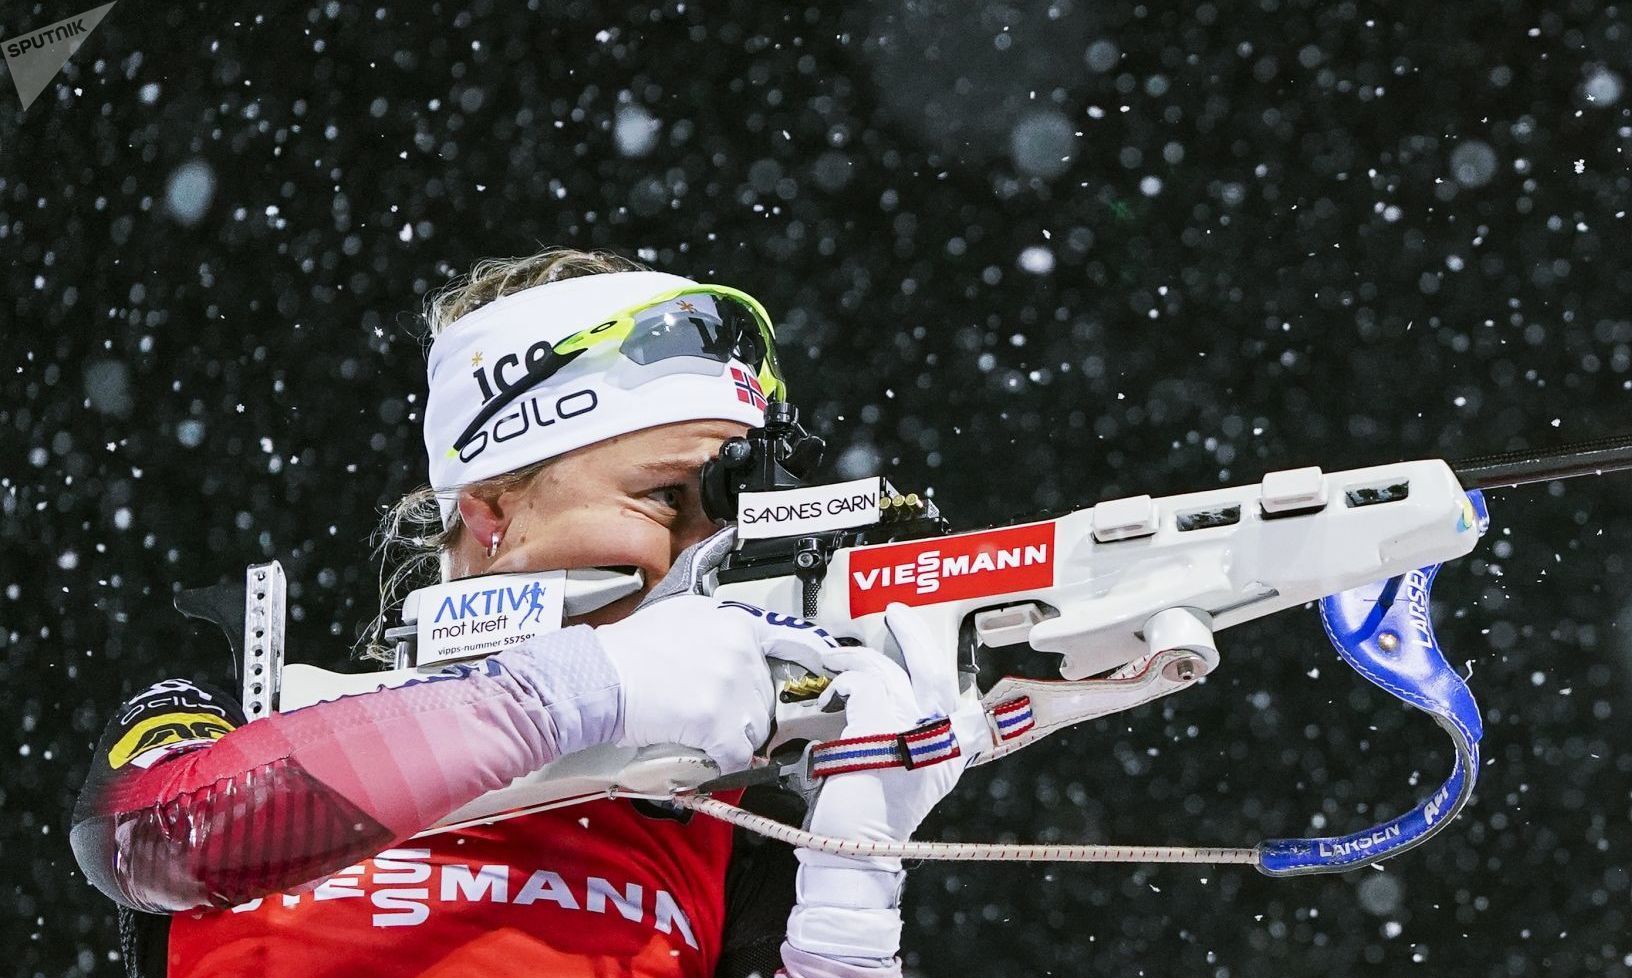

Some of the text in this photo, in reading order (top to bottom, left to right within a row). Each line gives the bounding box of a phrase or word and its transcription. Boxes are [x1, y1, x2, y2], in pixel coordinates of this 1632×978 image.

[459, 388, 598, 464] odlo
[742, 492, 876, 525] SANDNES GARN
[852, 542, 1047, 595] VIESSMANN
[434, 585, 530, 623] AKTIV
[432, 614, 509, 641] mot kreft
